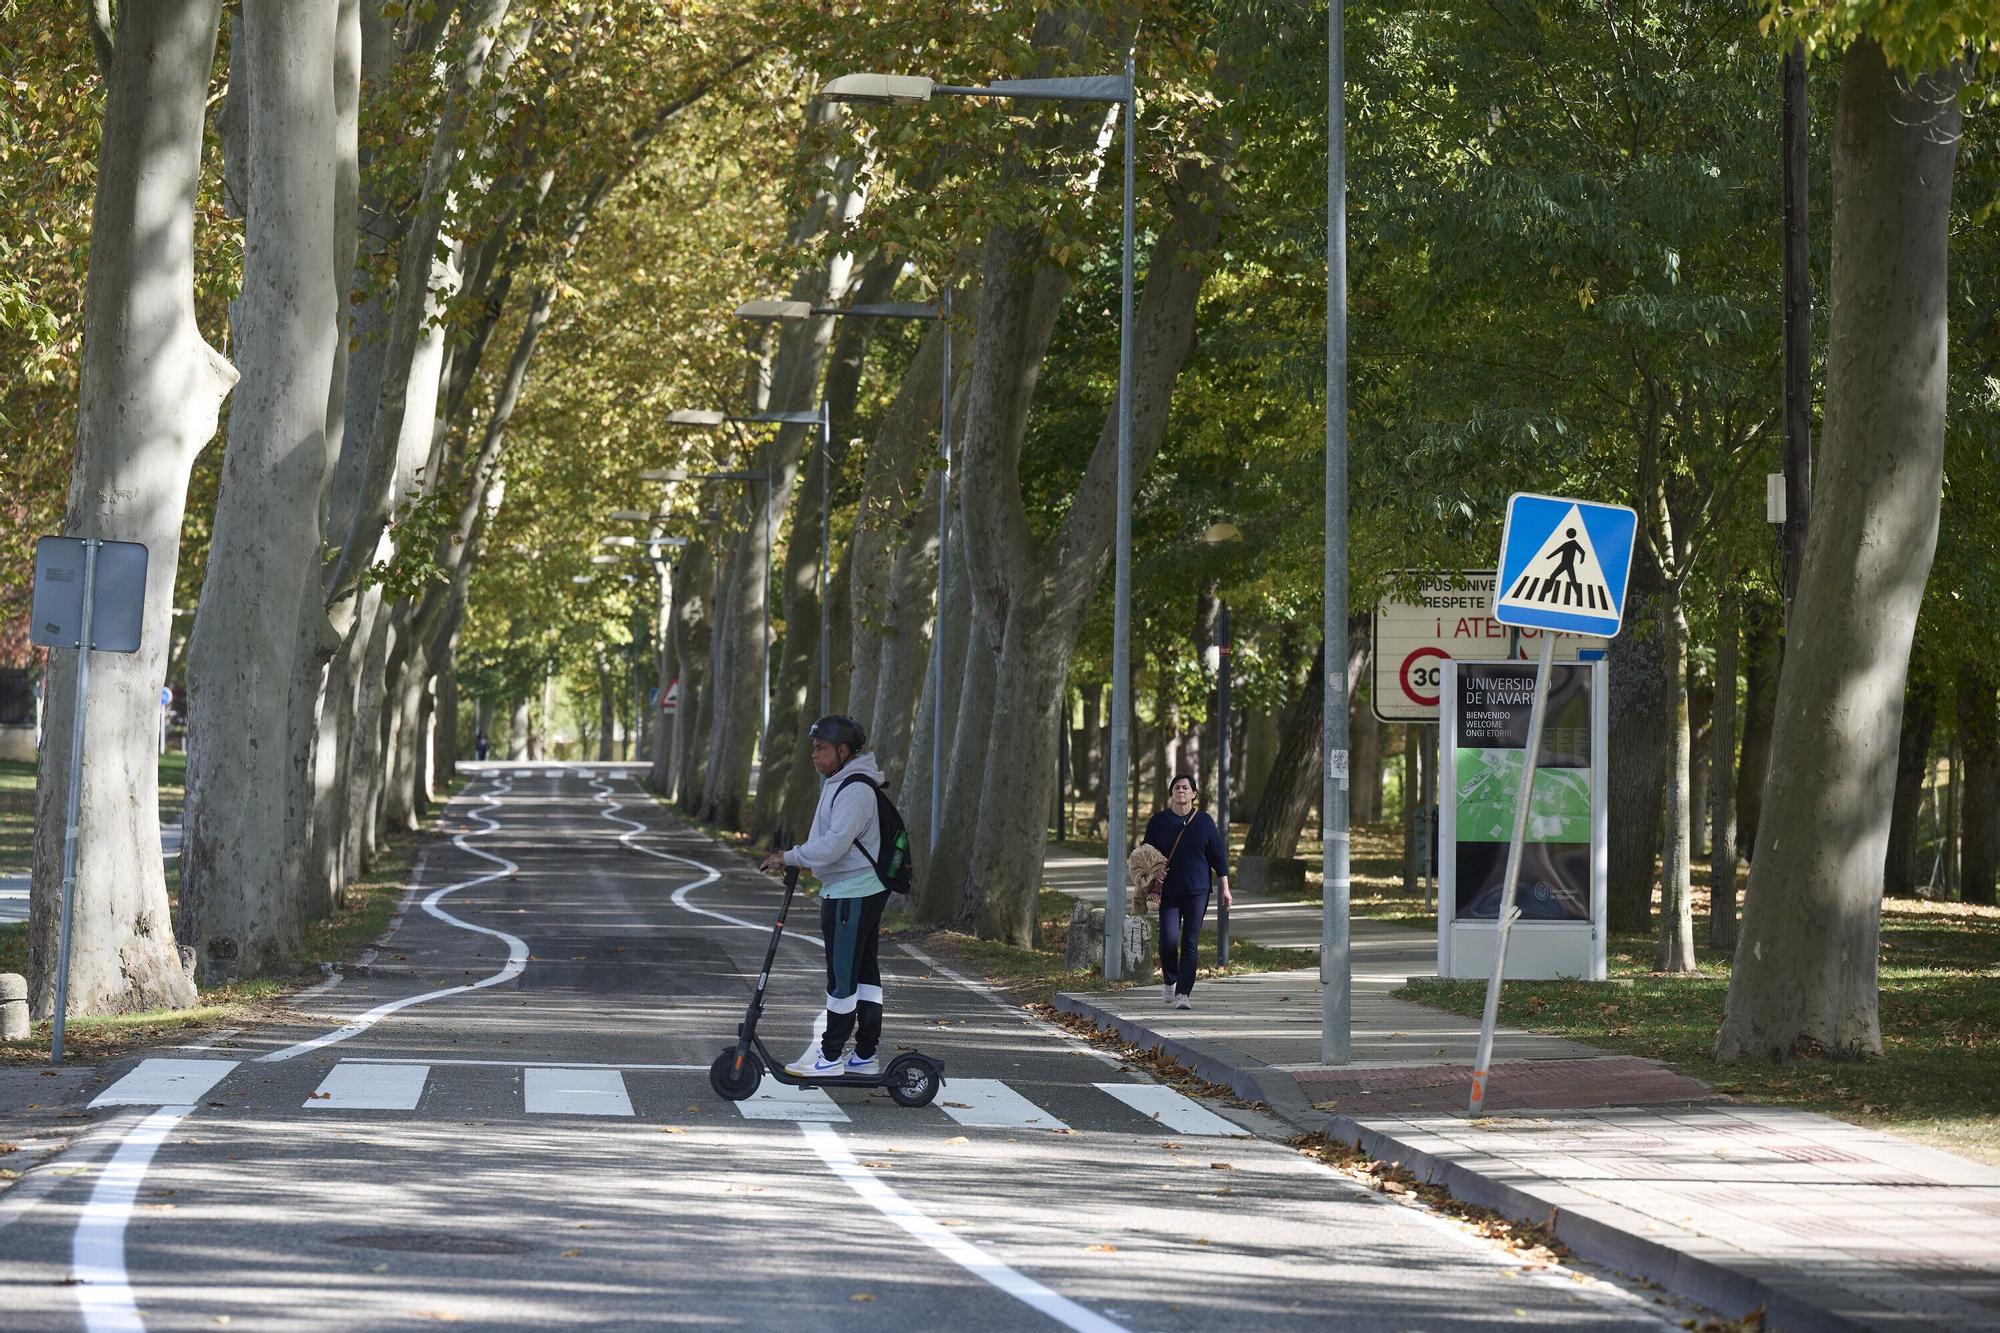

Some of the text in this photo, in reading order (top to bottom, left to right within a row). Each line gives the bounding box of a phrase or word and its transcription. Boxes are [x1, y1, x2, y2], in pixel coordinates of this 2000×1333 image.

[1424, 596, 1485, 609] RESPETE
[1413, 667, 1441, 687] 30
[1466, 678, 1552, 691] UNIVERSID
[1466, 692, 1547, 705] DE NAVAR
[1466, 711, 1511, 720] BIENVENIDO
[1466, 720, 1503, 729] WELCOME
[1466, 729, 1512, 737] ONGI ETORRI
